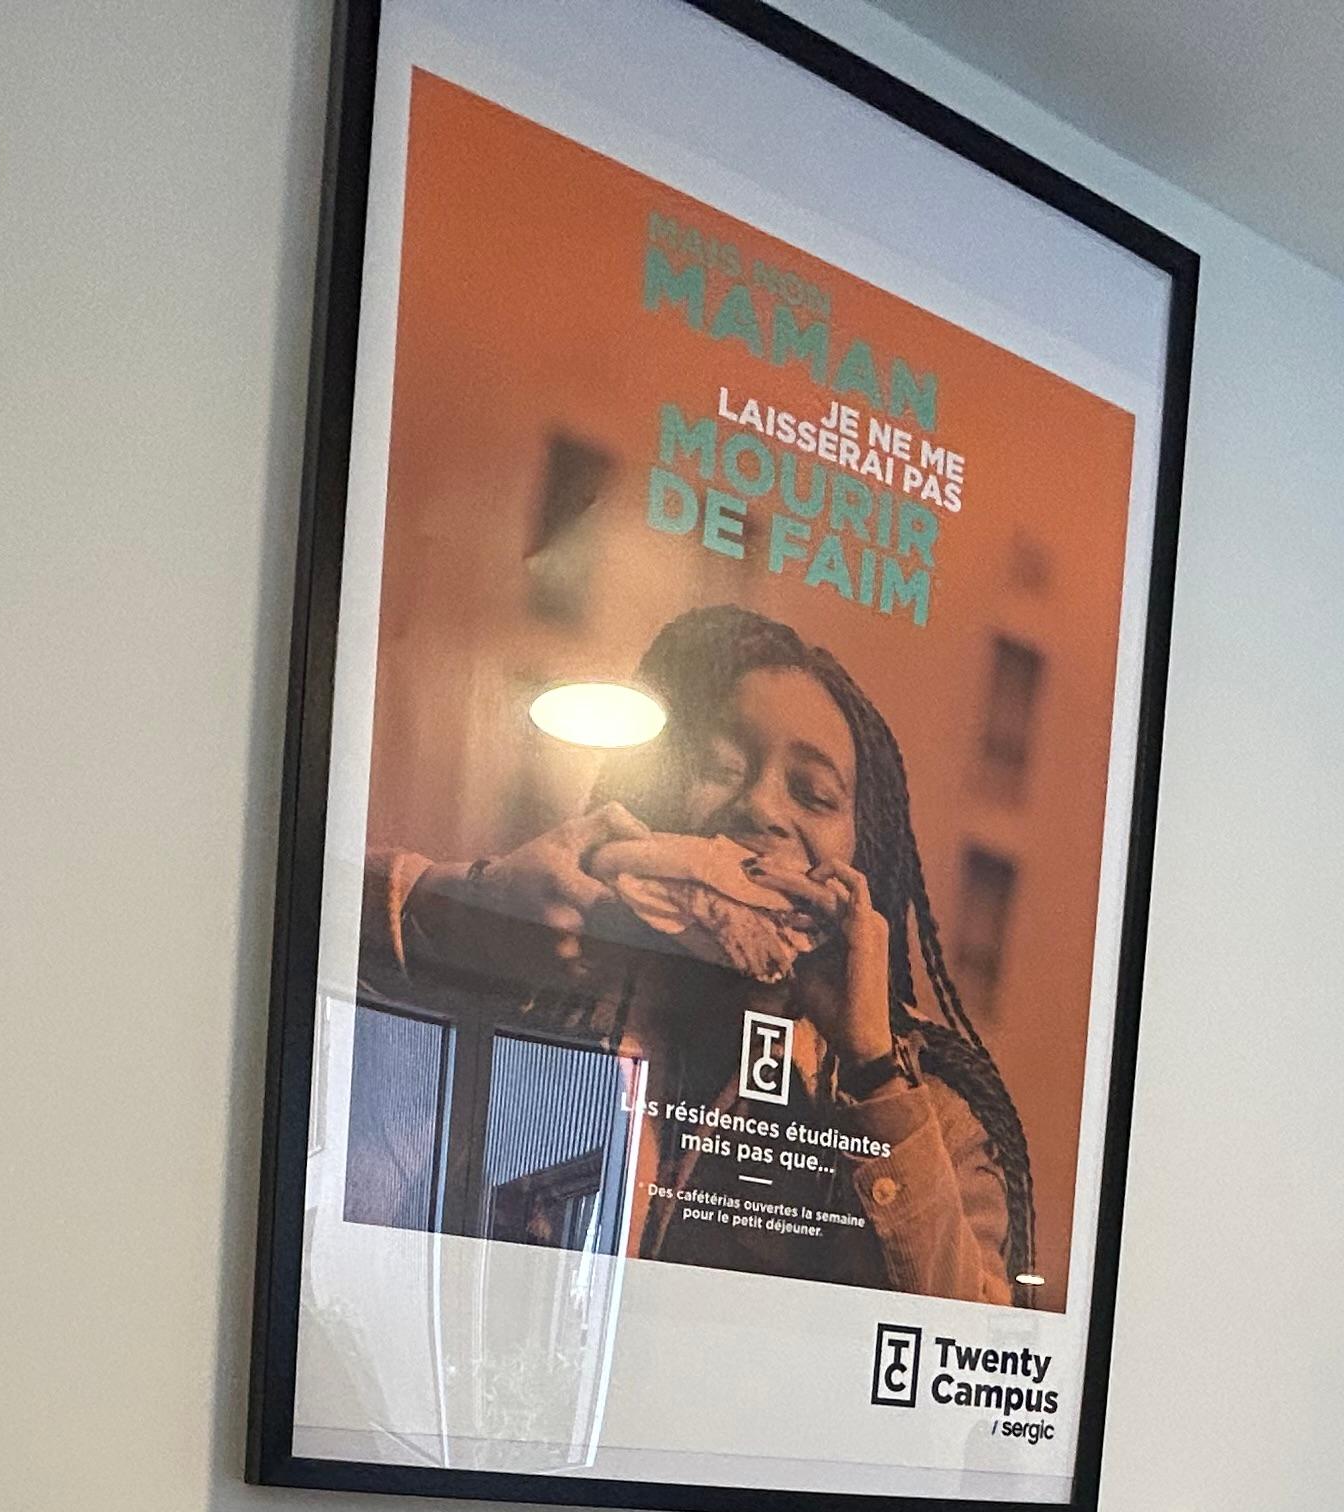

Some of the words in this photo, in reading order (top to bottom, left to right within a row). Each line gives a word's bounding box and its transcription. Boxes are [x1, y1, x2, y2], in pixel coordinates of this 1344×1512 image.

[642, 245, 939, 432] MAMAN
[718, 387, 894, 486] LAISSERAI
[903, 466, 962, 513] PAS
[821, 400, 861, 439] JE
[869, 418, 911, 462] NE
[921, 439, 966, 484] ME
[659, 403, 940, 567] MOURIR
[645, 466, 748, 560] DE
[768, 513, 933, 628] FAIM
[665, 1101, 780, 1140] résidences
[786, 1122, 892, 1159] étudiantes
[680, 1132, 732, 1157] mais
[737, 1143, 774, 1163] pas
[779, 1151, 835, 1174] que...
[647, 1183, 674, 1199] Des
[676, 1187, 740, 1210] cafétérias
[743, 1199, 799, 1219] ouvertes
[801, 1206, 813, 1221] la
[815, 1209, 866, 1228] semaine
[683, 1205, 715, 1223] pour
[717, 1209, 730, 1224] le
[732, 1213, 763, 1231] petit
[935, 1336, 1052, 1383] Twenty
[931, 1373, 1059, 1416] Campus
[1001, 1419, 1055, 1445] sergic
